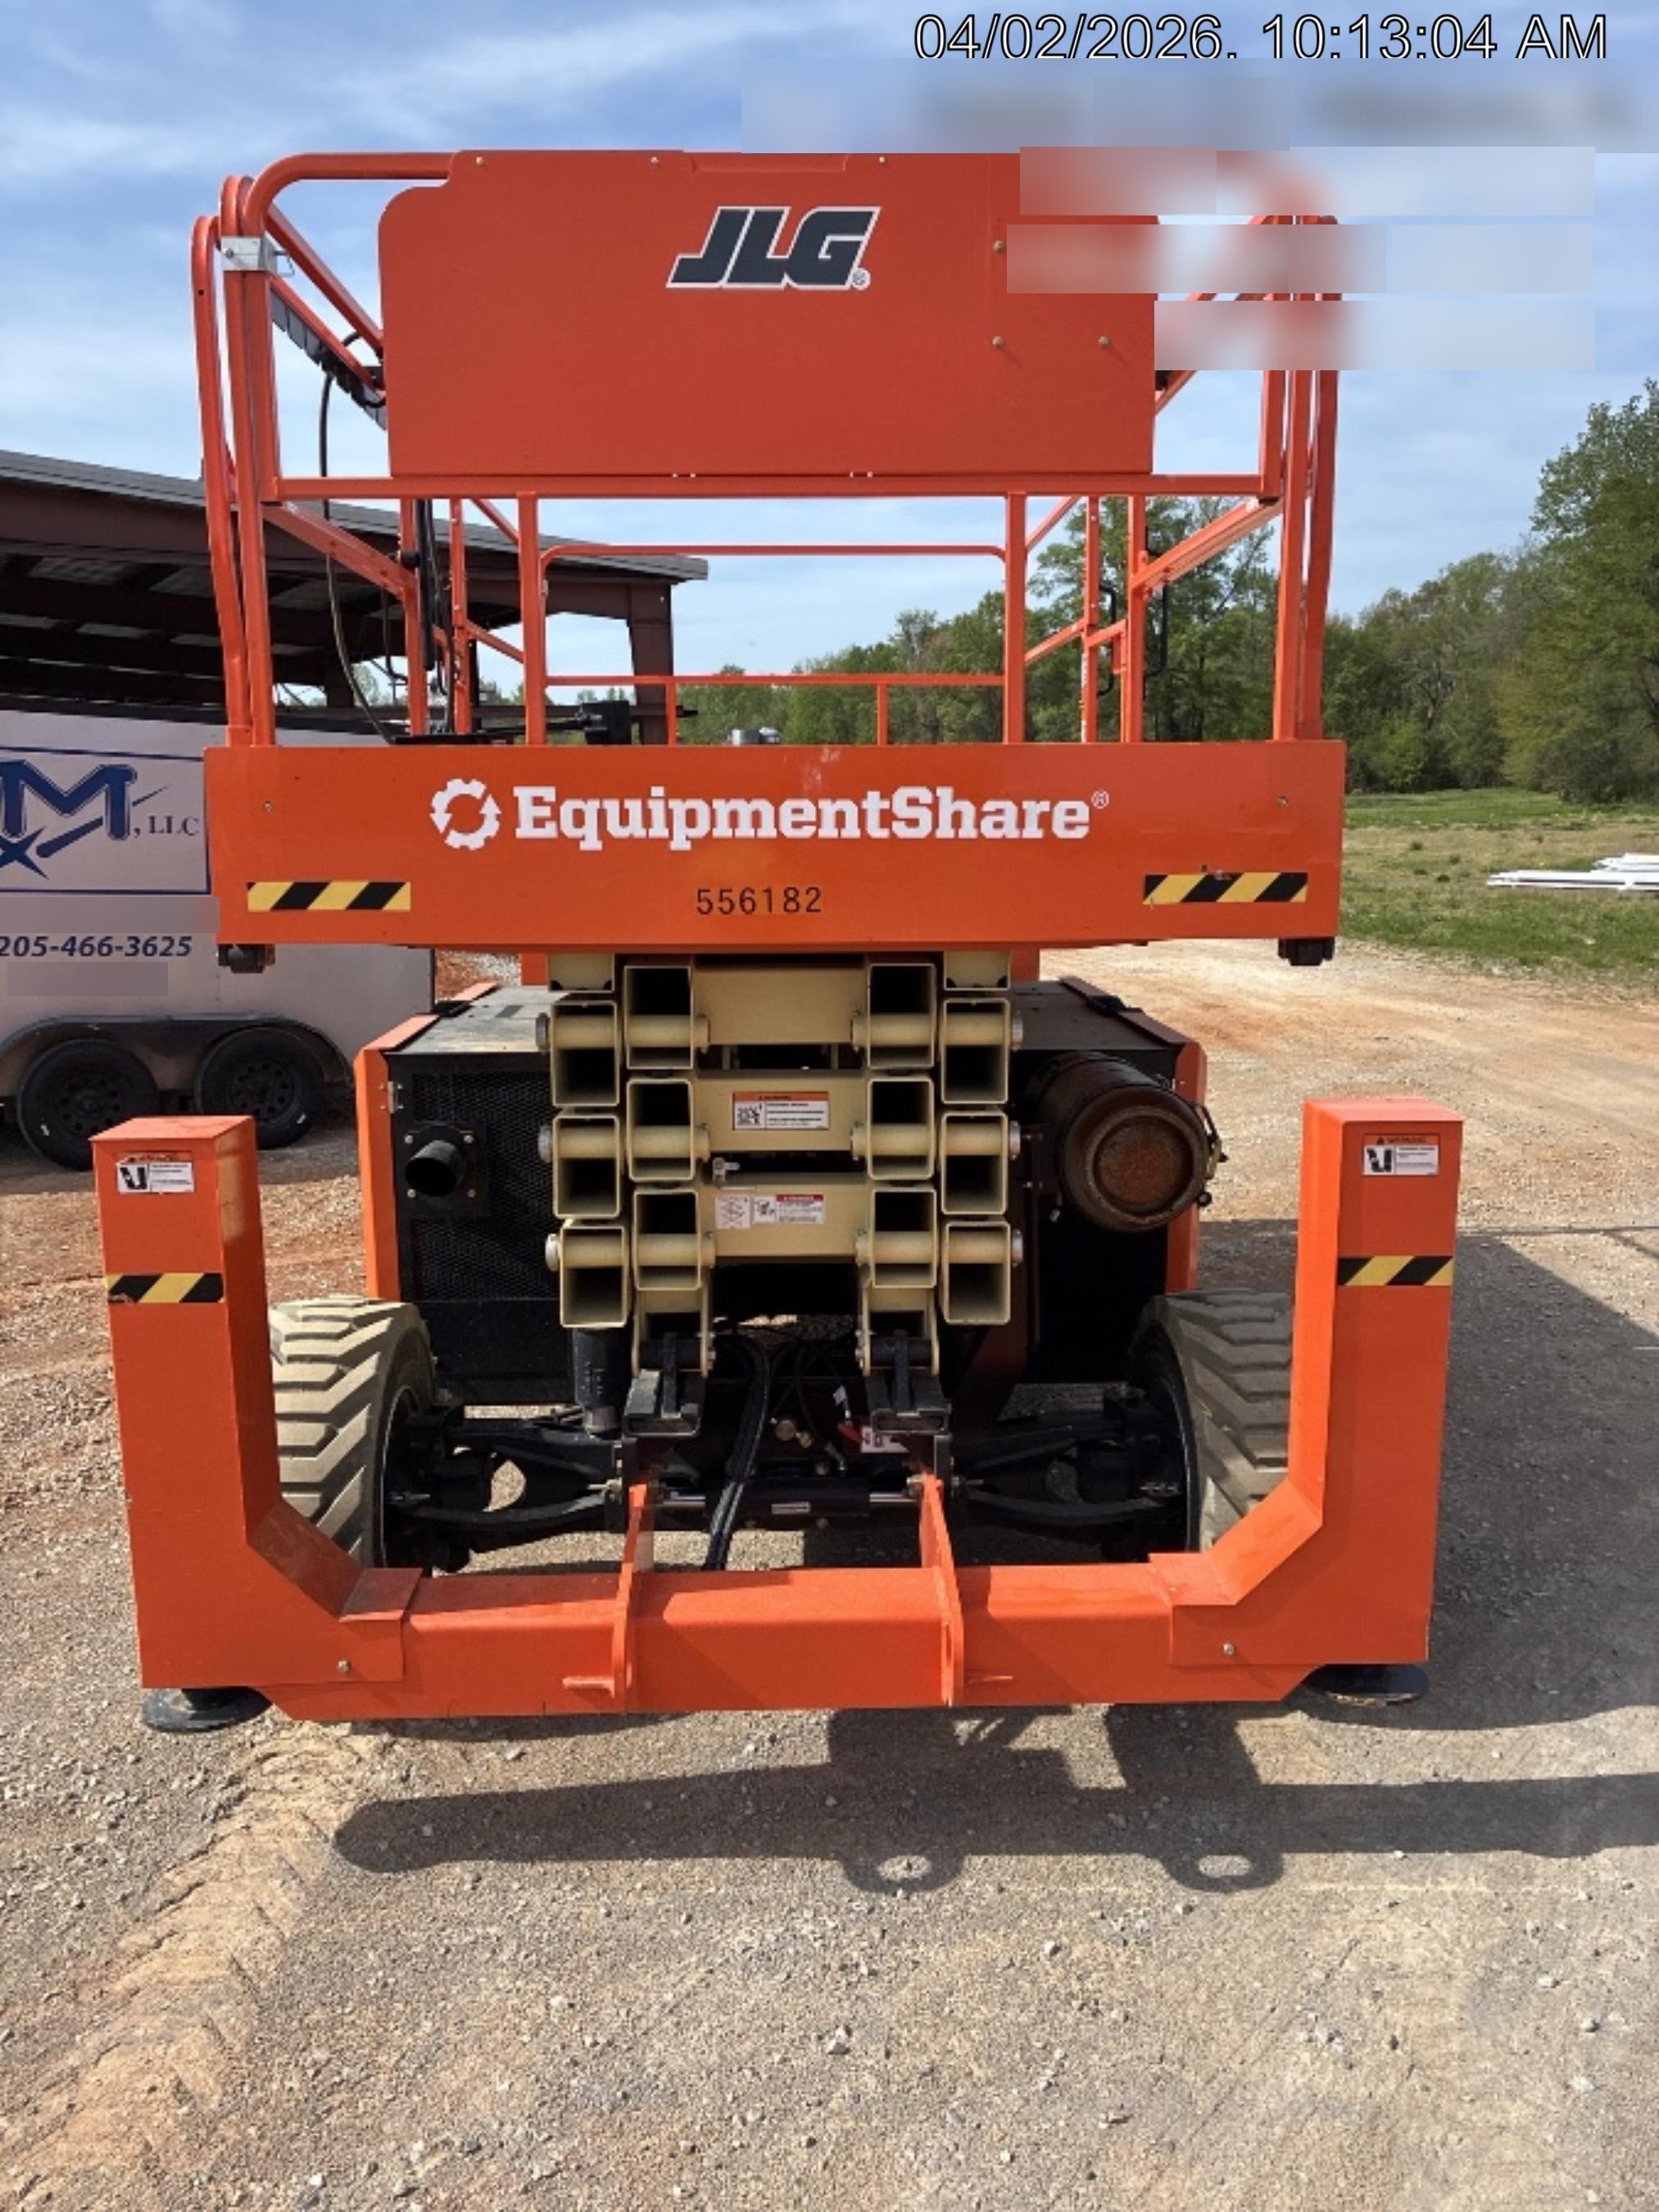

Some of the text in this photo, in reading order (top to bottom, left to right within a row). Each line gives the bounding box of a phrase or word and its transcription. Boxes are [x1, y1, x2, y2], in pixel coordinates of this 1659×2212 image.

[149, 815, 199, 836] LLC
[696, 886, 822, 915] 556182
[0, 936, 193, 957] 205-466-3625
